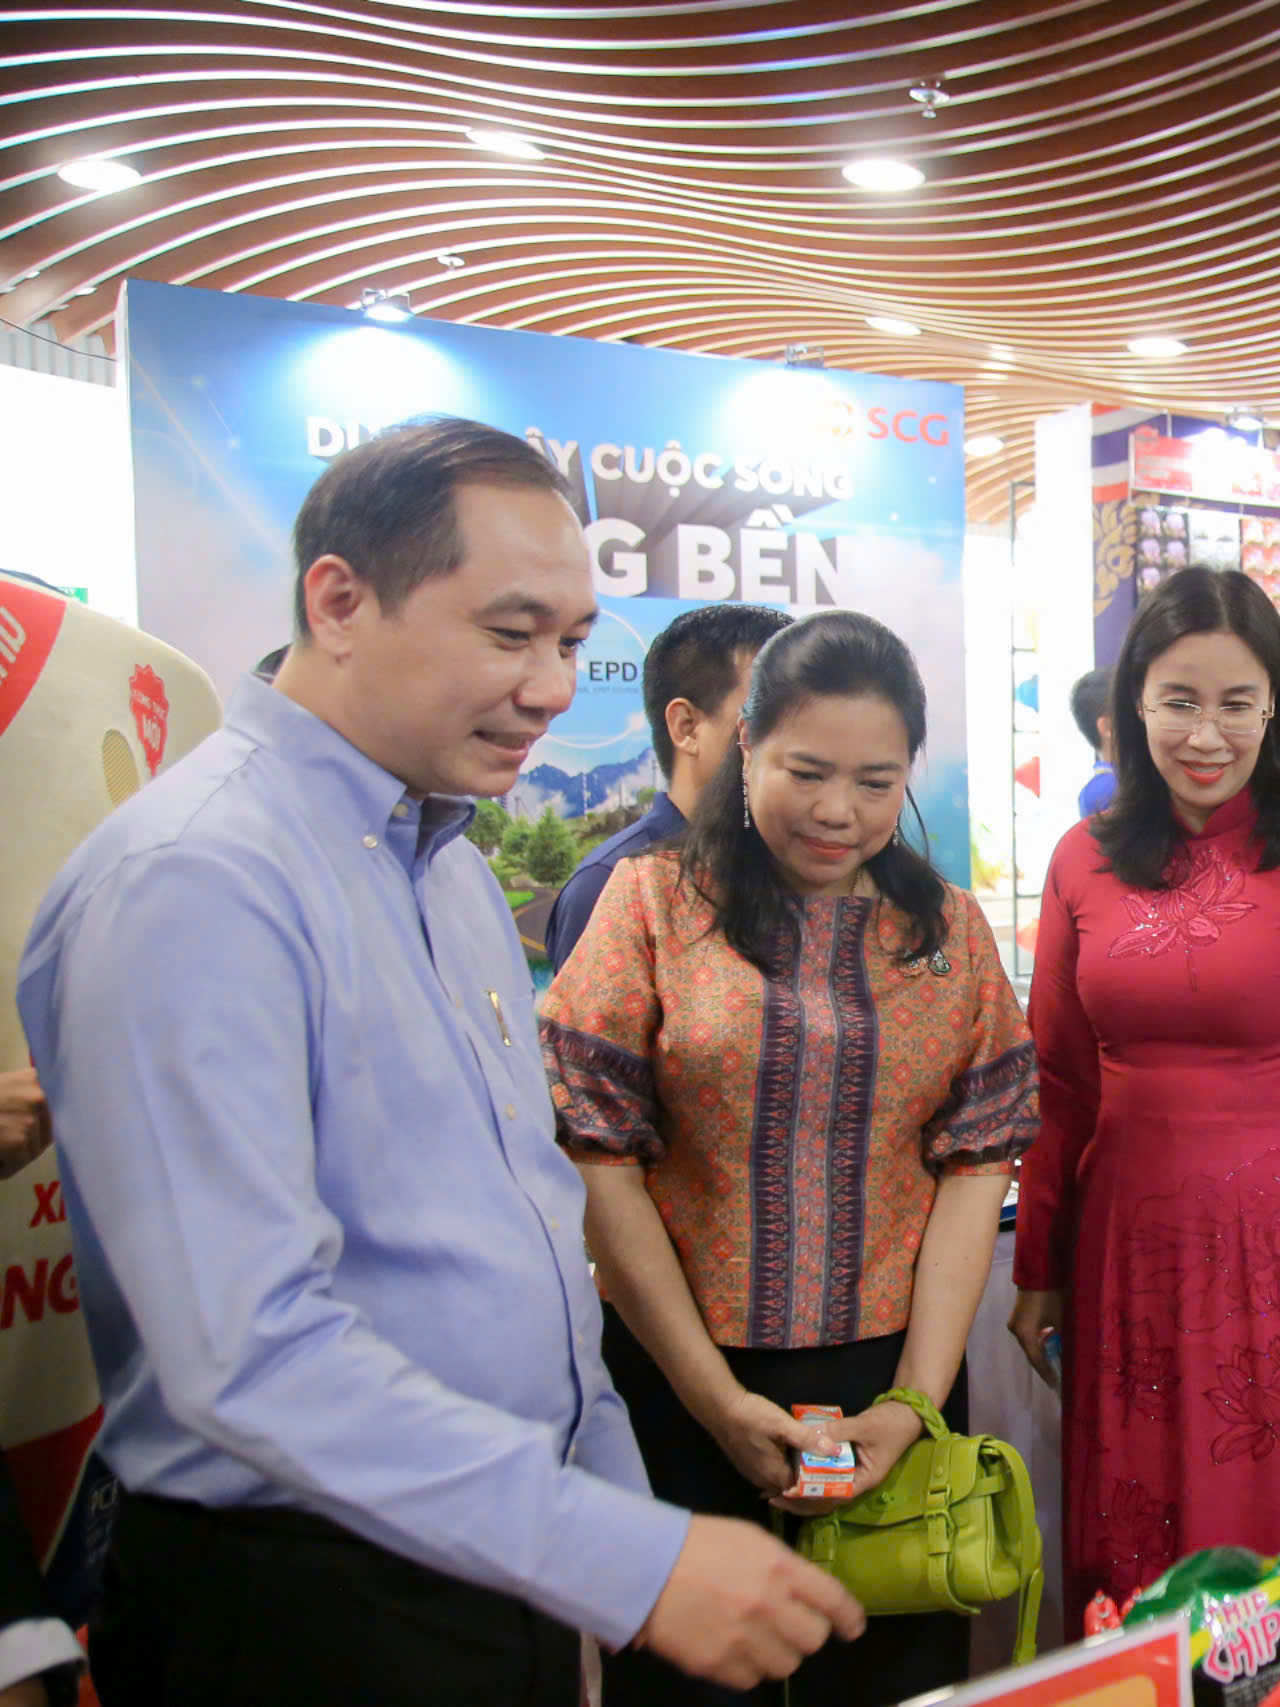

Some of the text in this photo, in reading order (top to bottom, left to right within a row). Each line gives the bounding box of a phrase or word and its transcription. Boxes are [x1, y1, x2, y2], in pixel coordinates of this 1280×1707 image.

[866, 406, 950, 447] SCG
[590, 440, 724, 497] CUỘC
[589, 661, 638, 682] EPD
